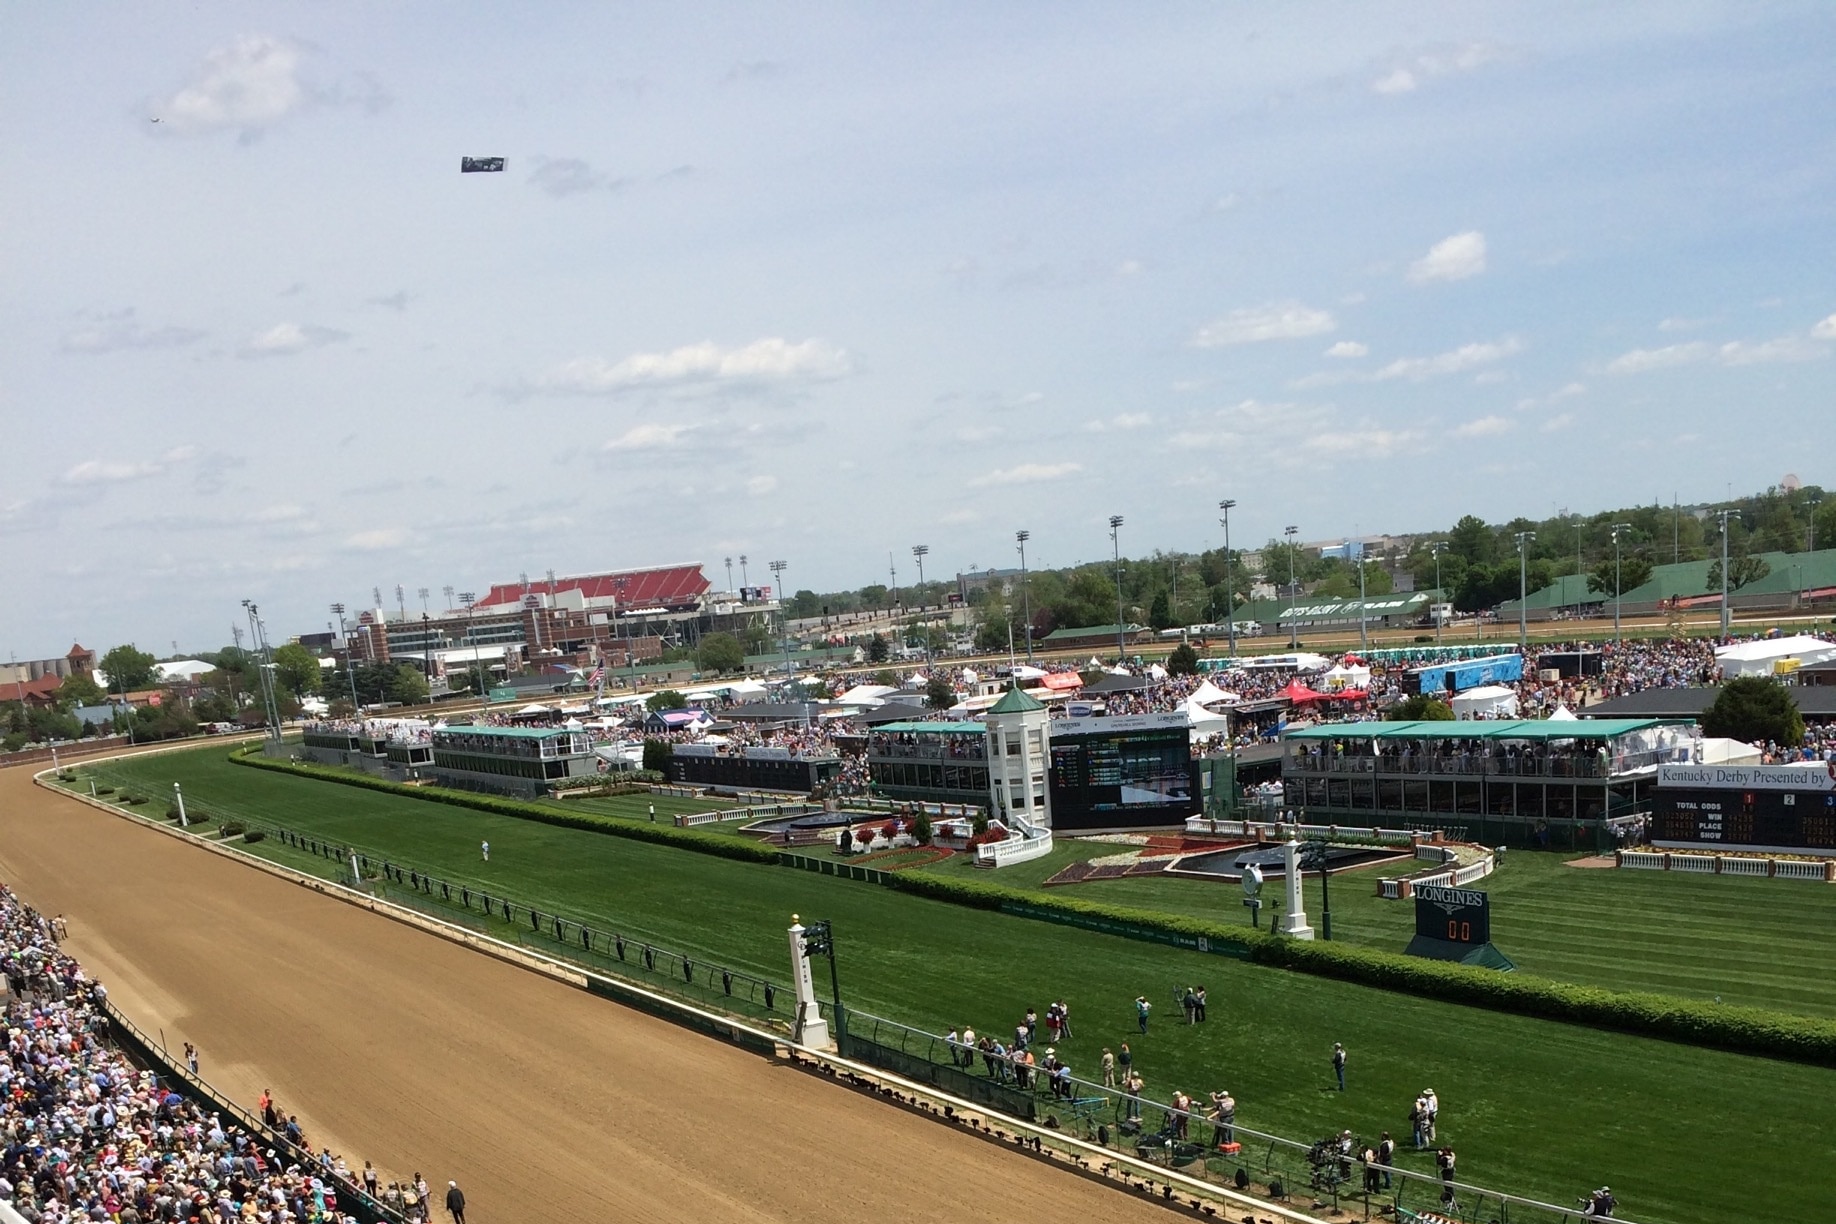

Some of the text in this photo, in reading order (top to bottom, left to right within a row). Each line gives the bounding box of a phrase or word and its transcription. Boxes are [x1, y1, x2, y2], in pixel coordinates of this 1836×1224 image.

[1662, 769, 1713, 785] Kentucky
[1716, 769, 1750, 786] Derby
[1753, 770, 1808, 785] Presented
[1811, 771, 1827, 787] by
[1787, 795, 1793, 804] 2
[1827, 796, 1834, 806] 3
[1676, 802, 1698, 810] TOTAL
[1707, 813, 1722, 821] WIN
[1698, 822, 1723, 830] PLACE
[1700, 831, 1722, 839] SHOW
[1416, 885, 1483, 907] LONGINES
